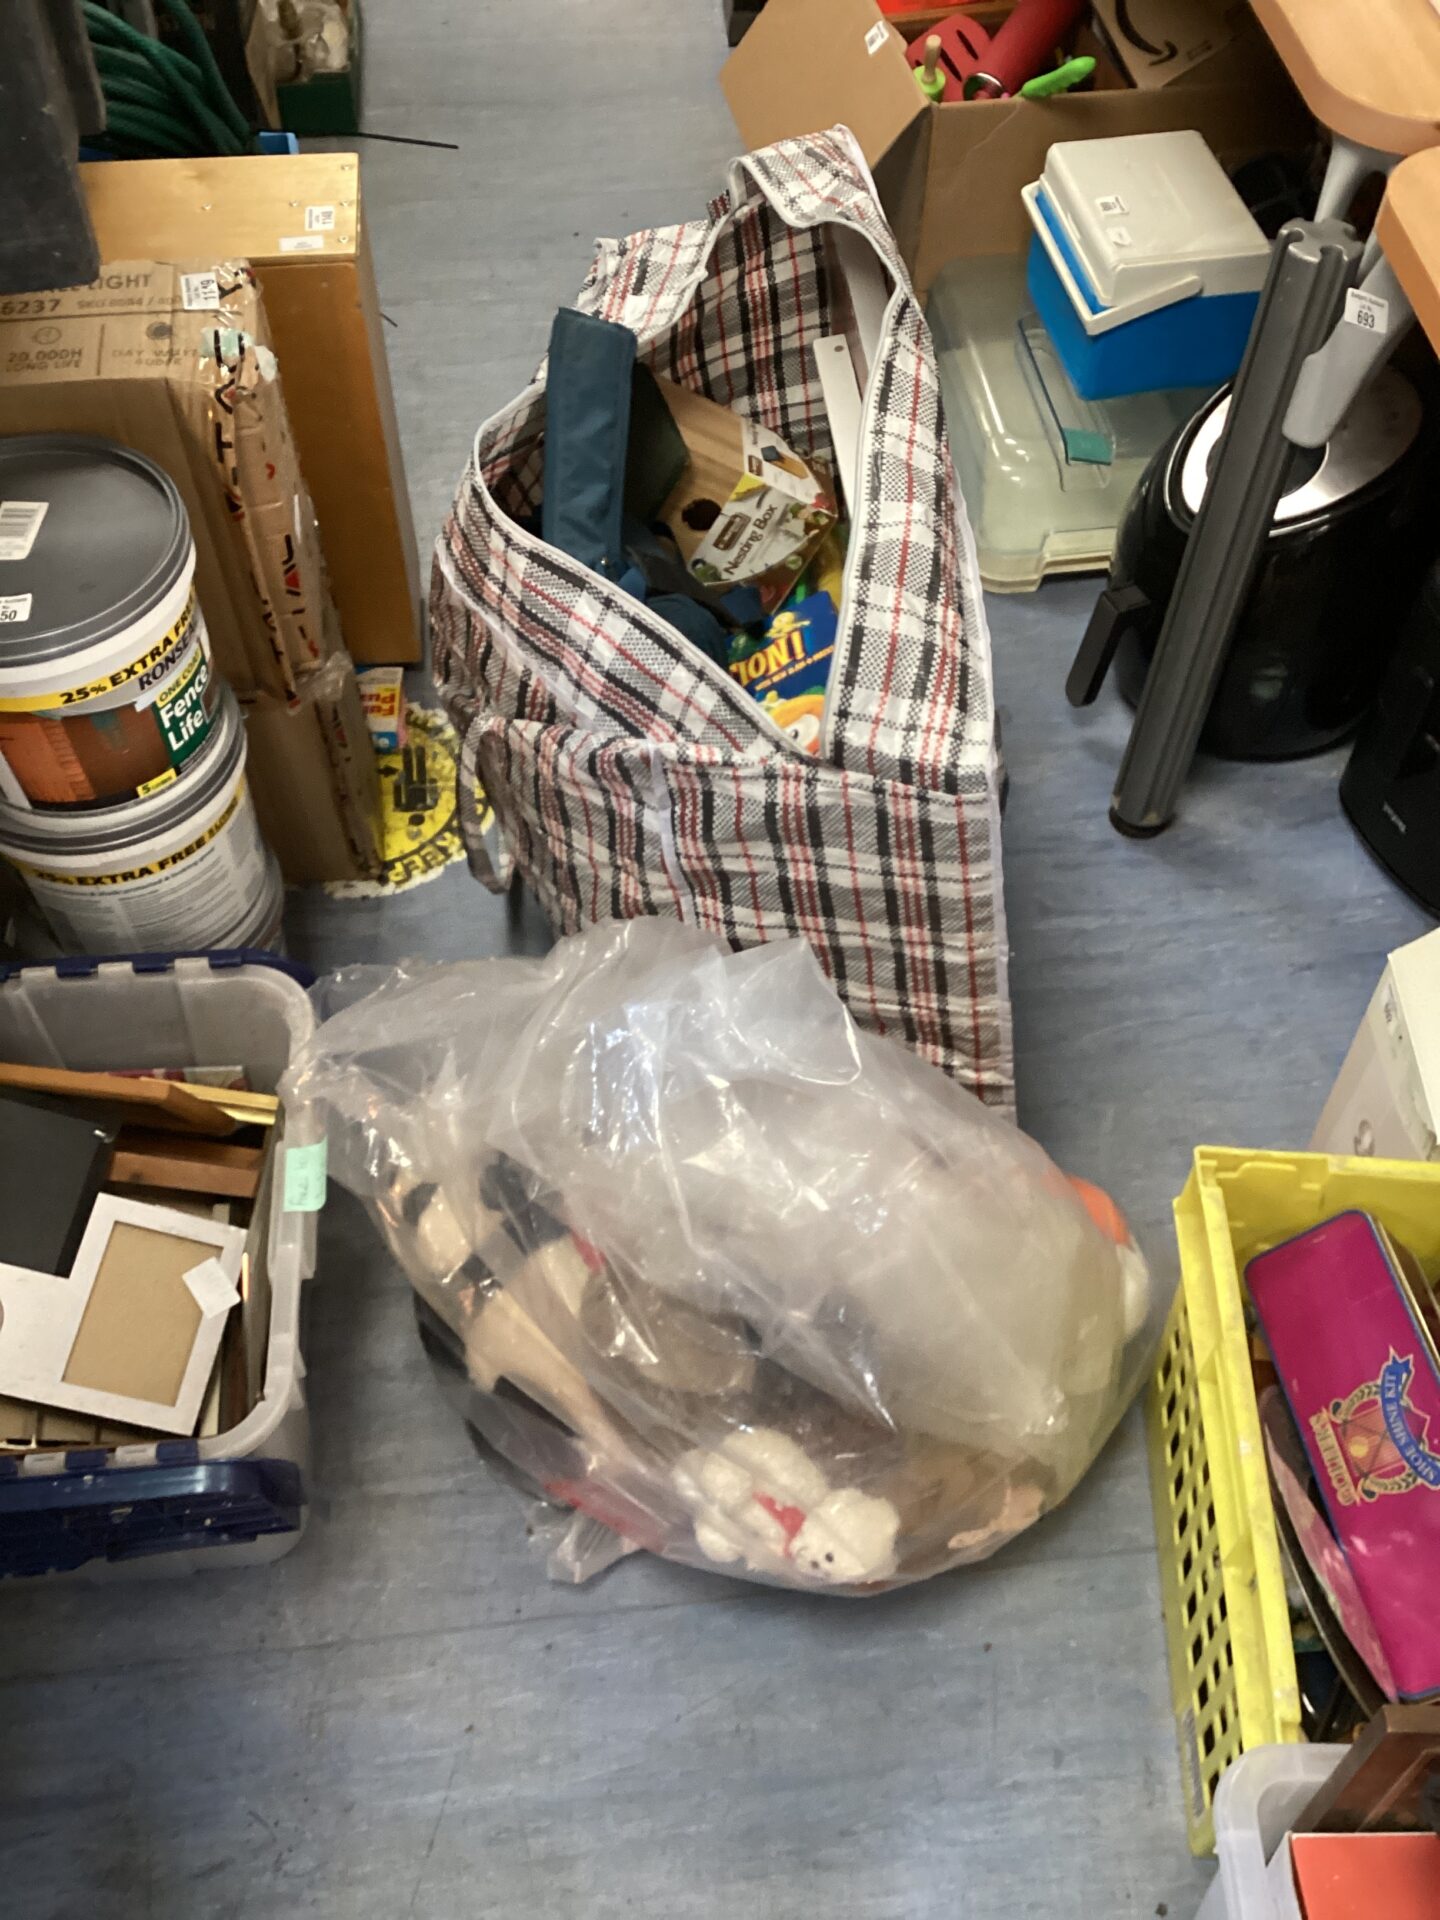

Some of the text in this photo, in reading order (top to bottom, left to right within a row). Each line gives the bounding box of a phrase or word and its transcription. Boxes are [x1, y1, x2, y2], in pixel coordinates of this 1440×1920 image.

[1357, 310, 1376, 328] 693
[724, 525, 765, 575] Nesting
[754, 503, 778, 532] Box
[60, 683, 107, 704] 25%
[109, 636, 173, 687] EXTRA
[159, 677, 182, 702] ONE
[159, 664, 208, 729] Fence
[167, 709, 204, 751] Life
[77, 867, 154, 886] EXTRA
[157, 835, 206, 871] FREE
[387, 831, 462, 884] KEEP
[1384, 1372, 1435, 1481] SHOE SHINE KIT
